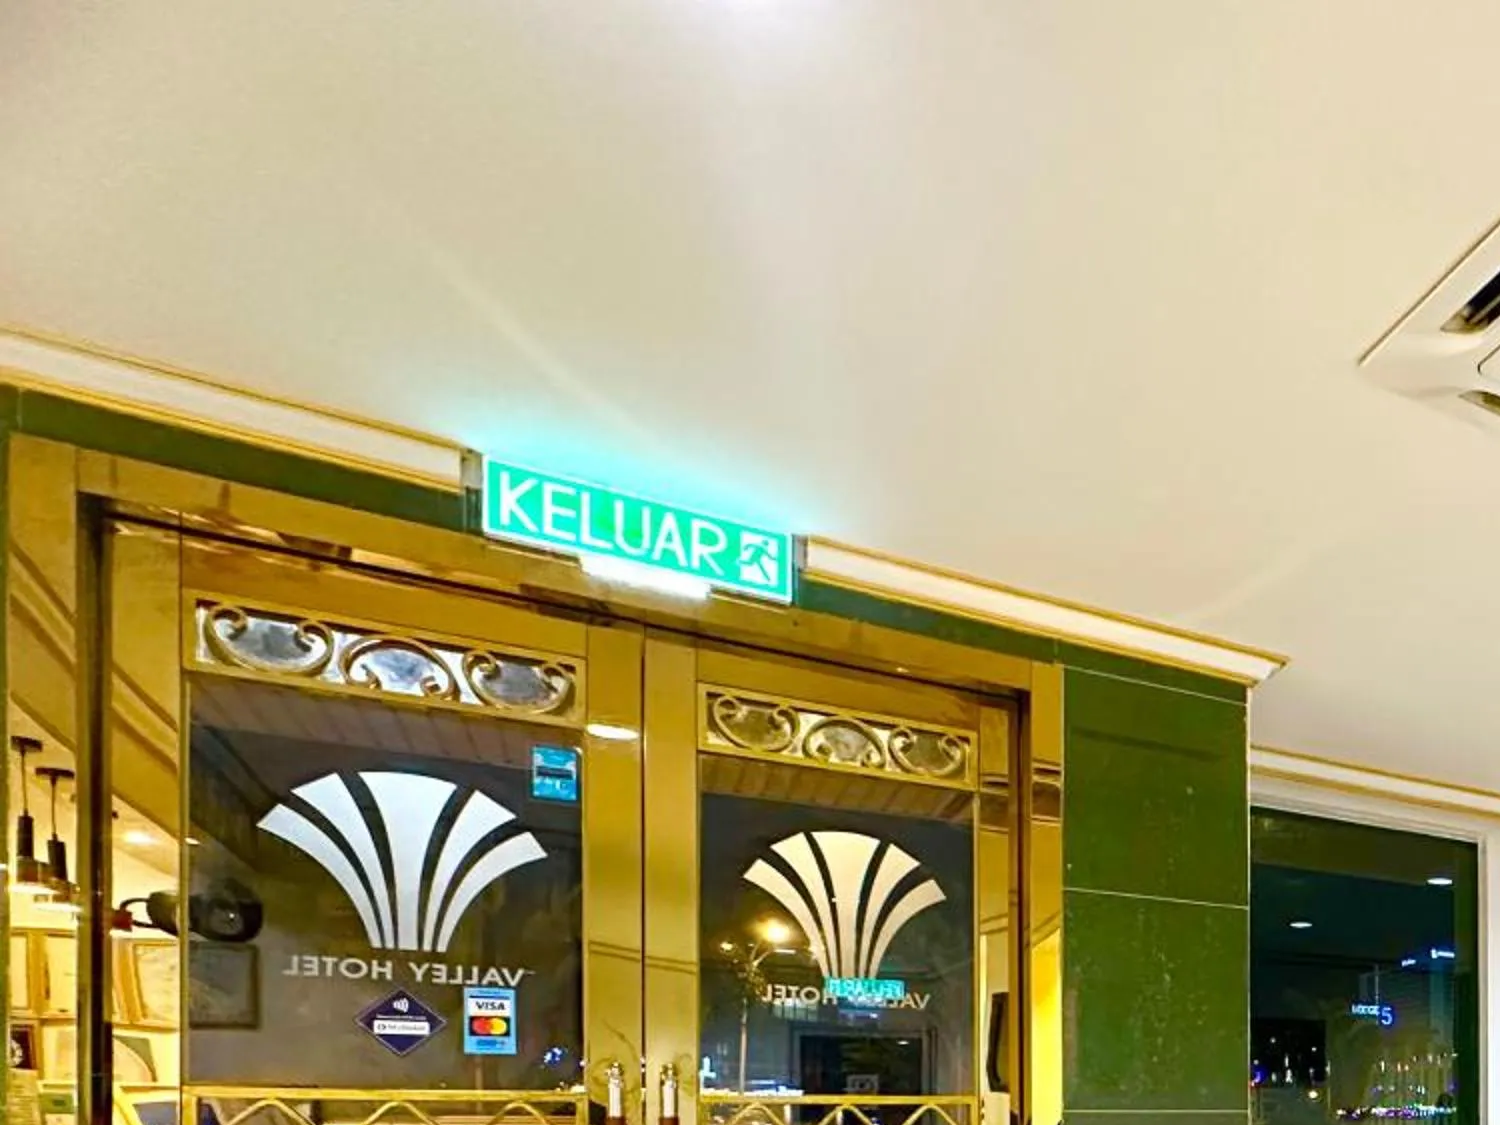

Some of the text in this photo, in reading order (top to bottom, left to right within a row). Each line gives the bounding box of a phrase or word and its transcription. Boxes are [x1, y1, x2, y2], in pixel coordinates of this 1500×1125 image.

[498, 470, 728, 576] KELUAR
[475, 1001, 507, 1011] VISA
[1381, 1006, 1394, 1026] 5
